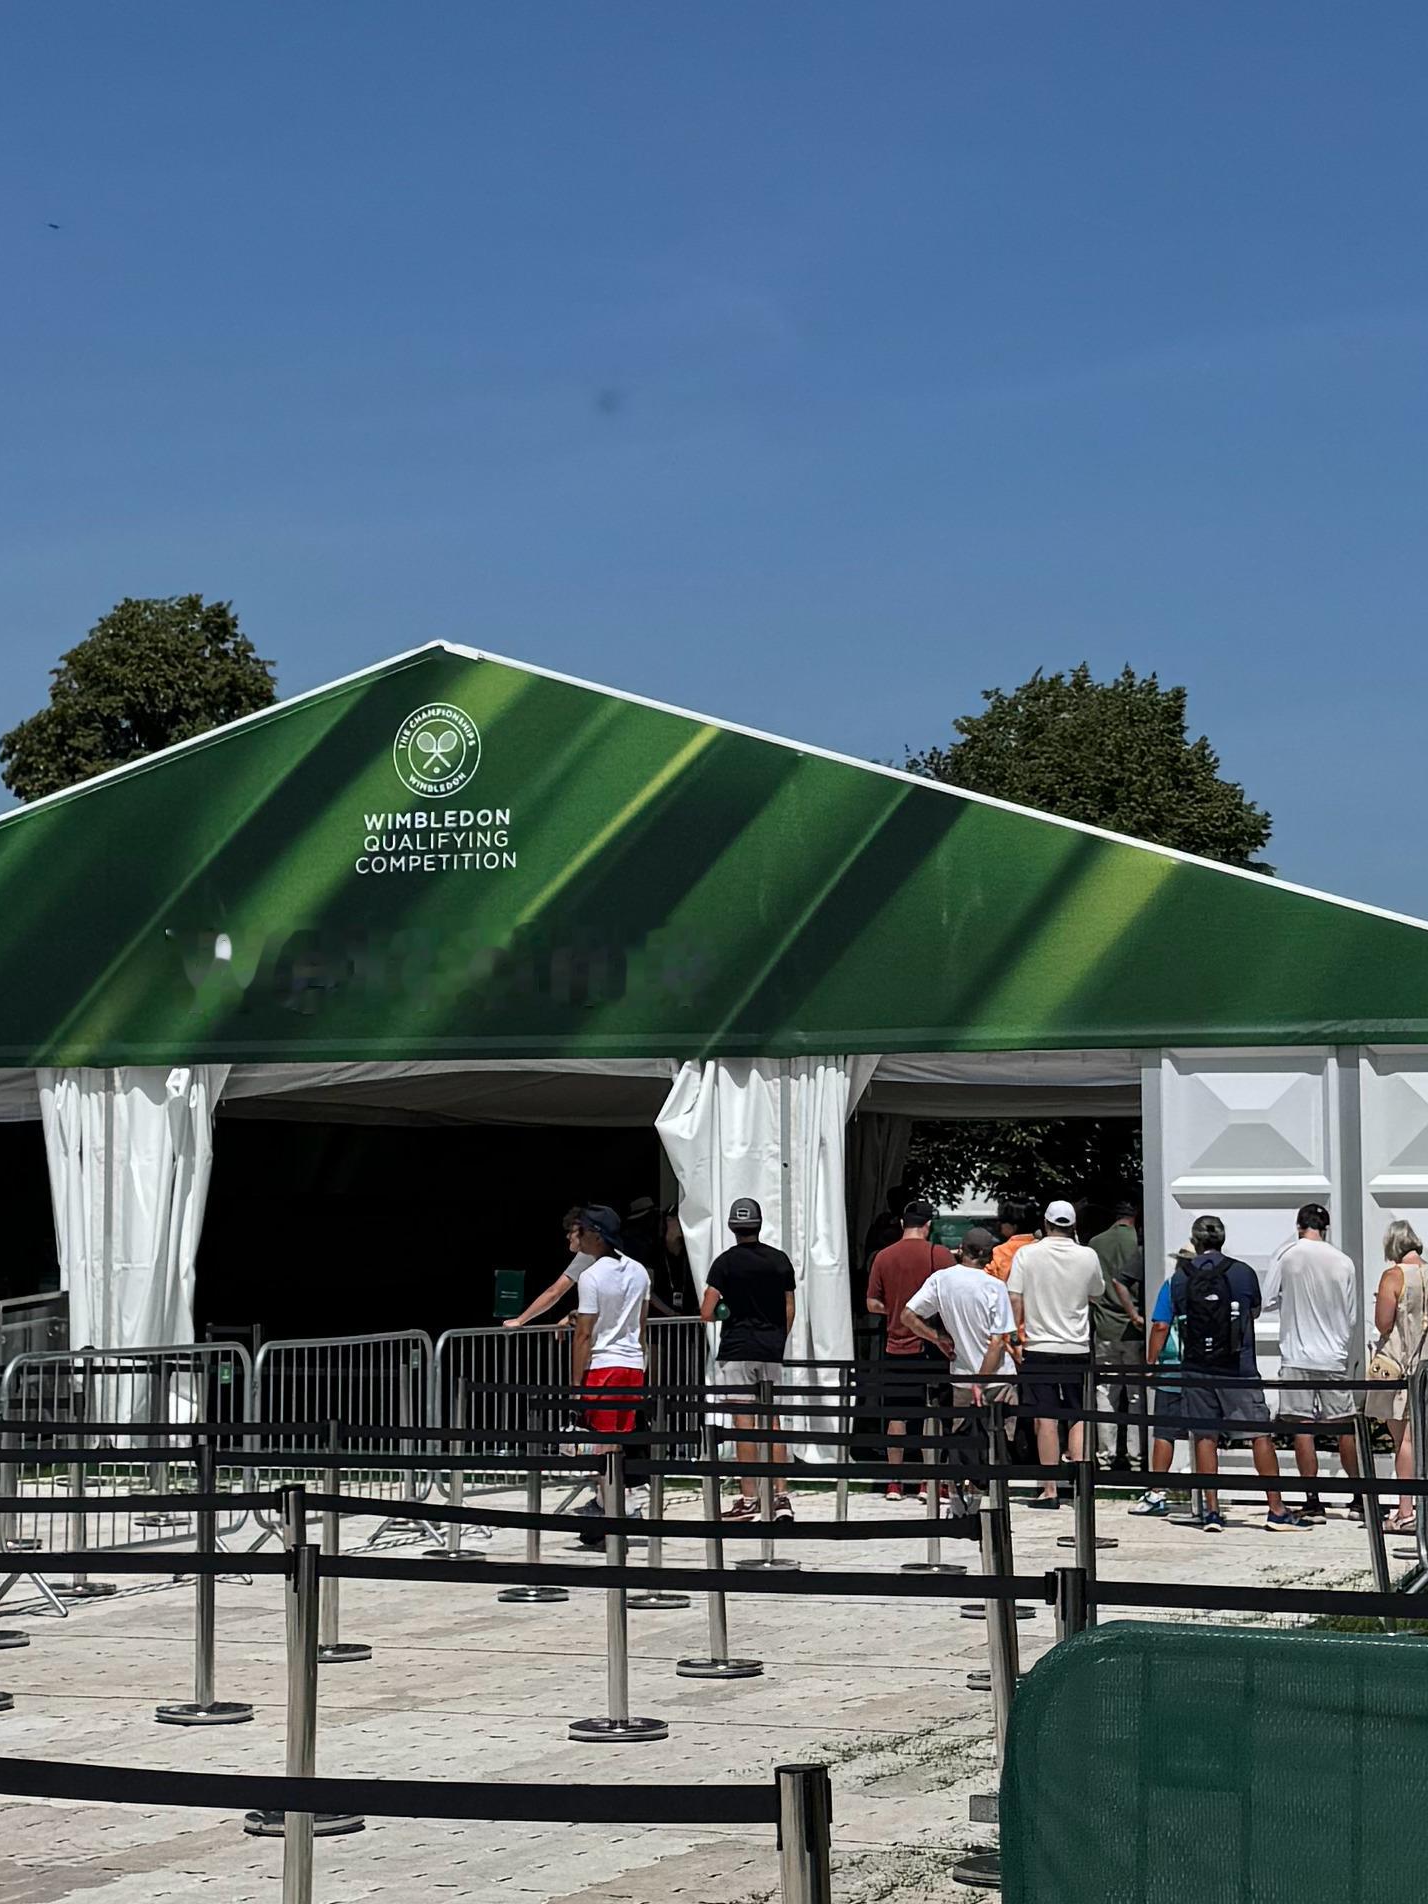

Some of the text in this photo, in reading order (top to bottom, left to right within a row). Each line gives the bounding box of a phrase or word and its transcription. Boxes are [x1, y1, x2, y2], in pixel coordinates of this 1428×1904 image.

[363, 808, 511, 831] WIMBLEDON
[363, 830, 509, 852] QUALIFYING
[355, 851, 517, 874] COMPETITION
